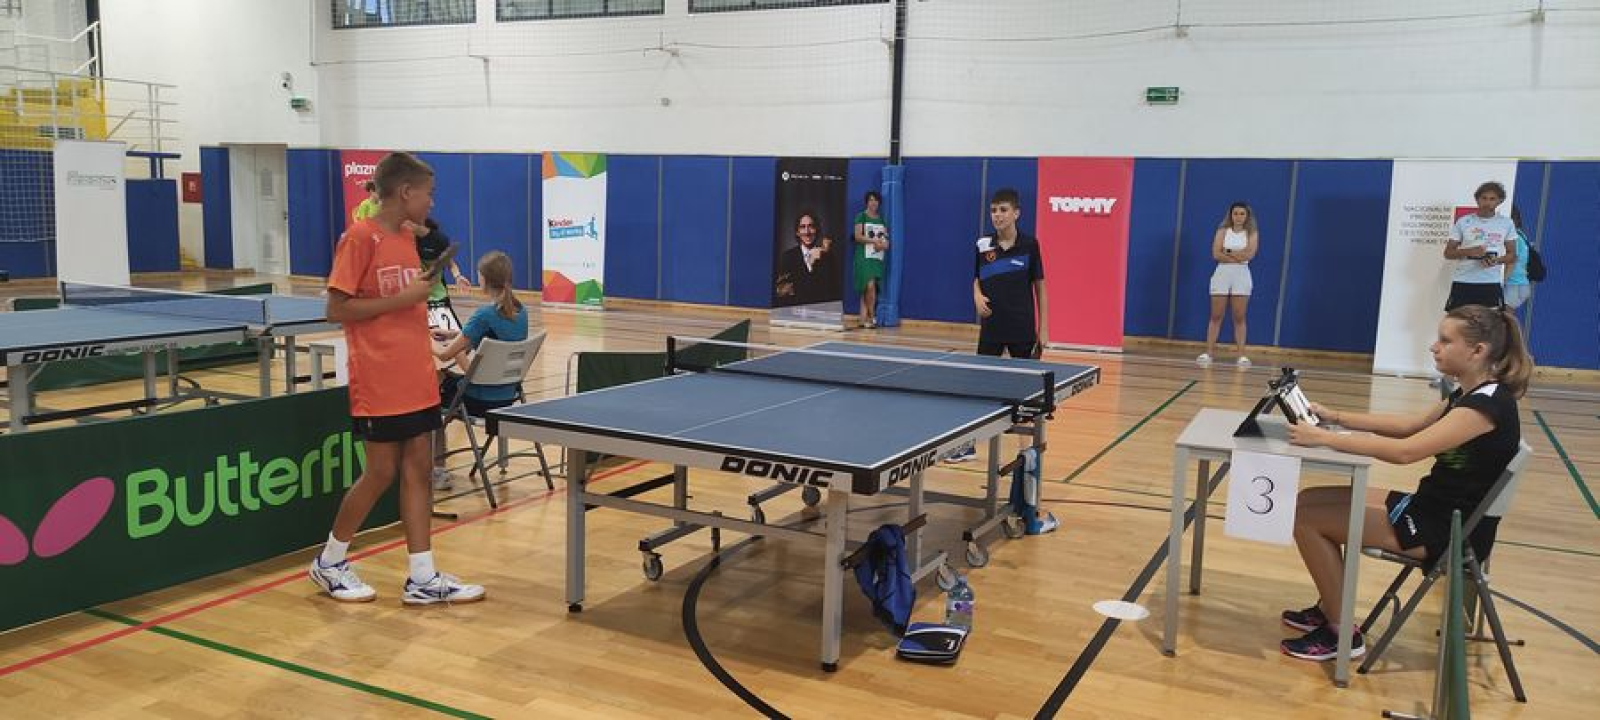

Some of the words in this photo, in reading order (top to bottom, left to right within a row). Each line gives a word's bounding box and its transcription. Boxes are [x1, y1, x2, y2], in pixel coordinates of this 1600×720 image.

[1049, 197, 1117, 213] TOMMY
[22, 346, 105, 364] DONIC
[1071, 375, 1095, 397] DONIC
[720, 456, 834, 487] DONIC
[888, 450, 938, 487] DONIC
[1246, 475, 1275, 515] 3
